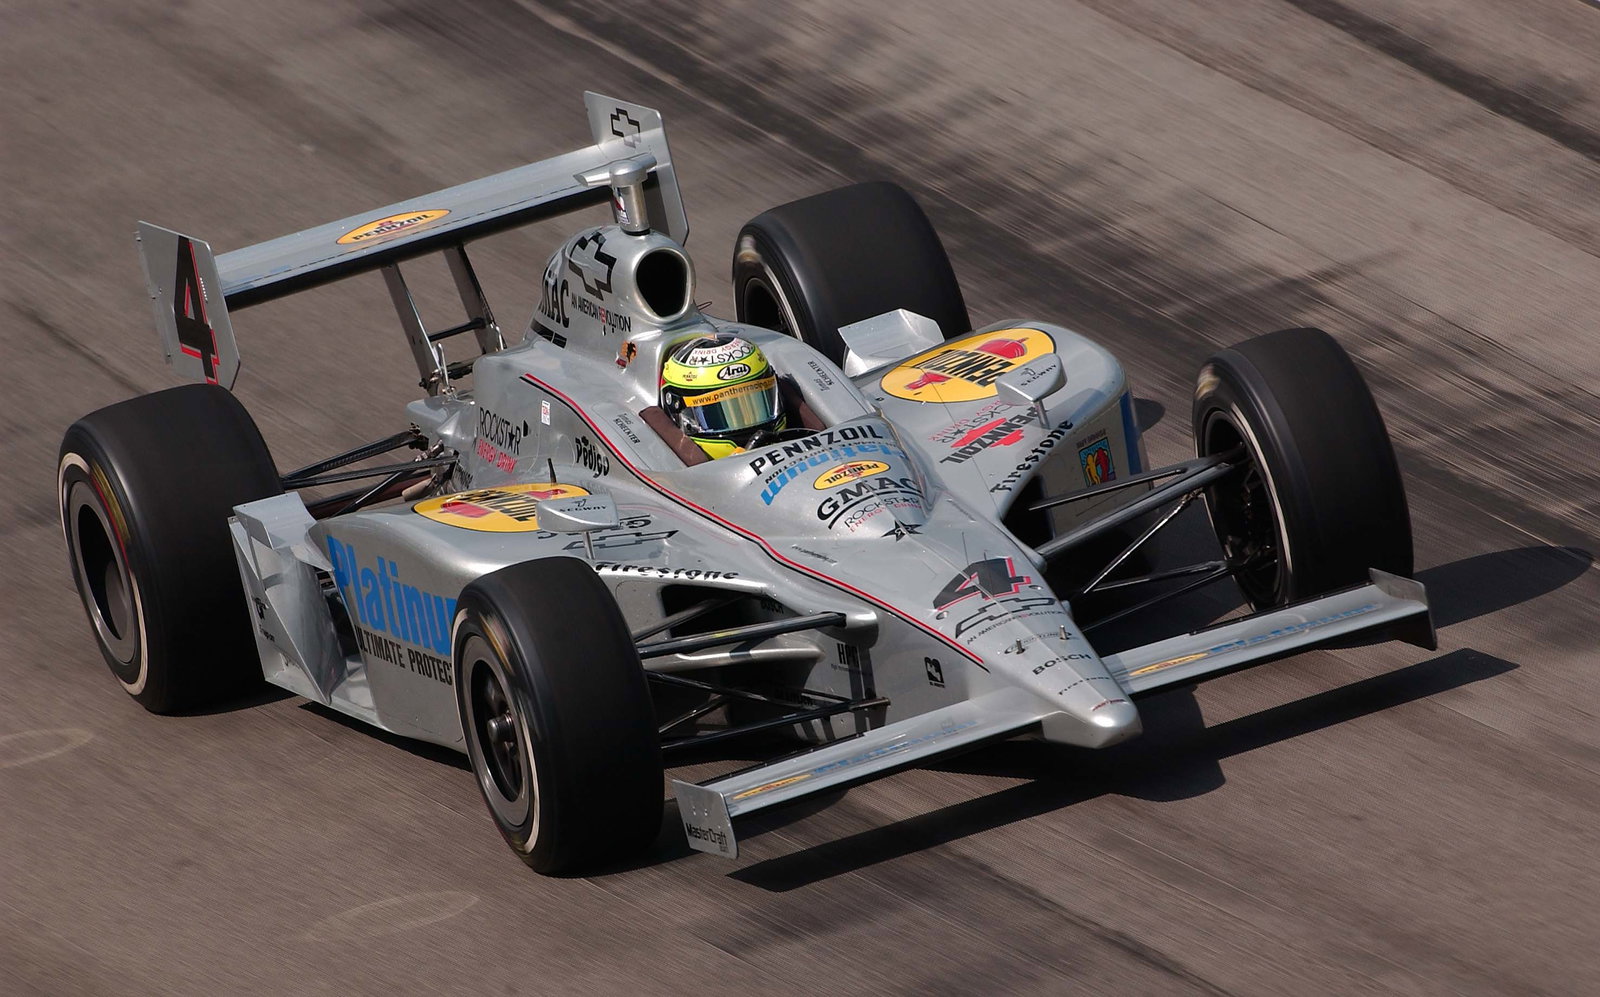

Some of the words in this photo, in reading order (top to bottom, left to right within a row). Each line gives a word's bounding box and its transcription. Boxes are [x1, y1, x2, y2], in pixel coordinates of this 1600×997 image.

[352, 213, 435, 241] PENNZOIL
[173, 235, 221, 385] 4
[722, 365, 747, 376] Arai
[749, 424, 884, 477] PENNZOIL
[939, 406, 1040, 464] PENNZOIL
[825, 462, 881, 485] PENNZOIL
[989, 420, 1074, 493] Firestone
[816, 476, 922, 521] GMAC
[594, 561, 740, 580] Firestone
[933, 556, 1032, 612] 4
[326, 535, 458, 656] Platinu
[407, 648, 453, 686] PROTEC
[1032, 652, 1092, 676] BOSCH
[685, 822, 728, 847] MasterCraft
